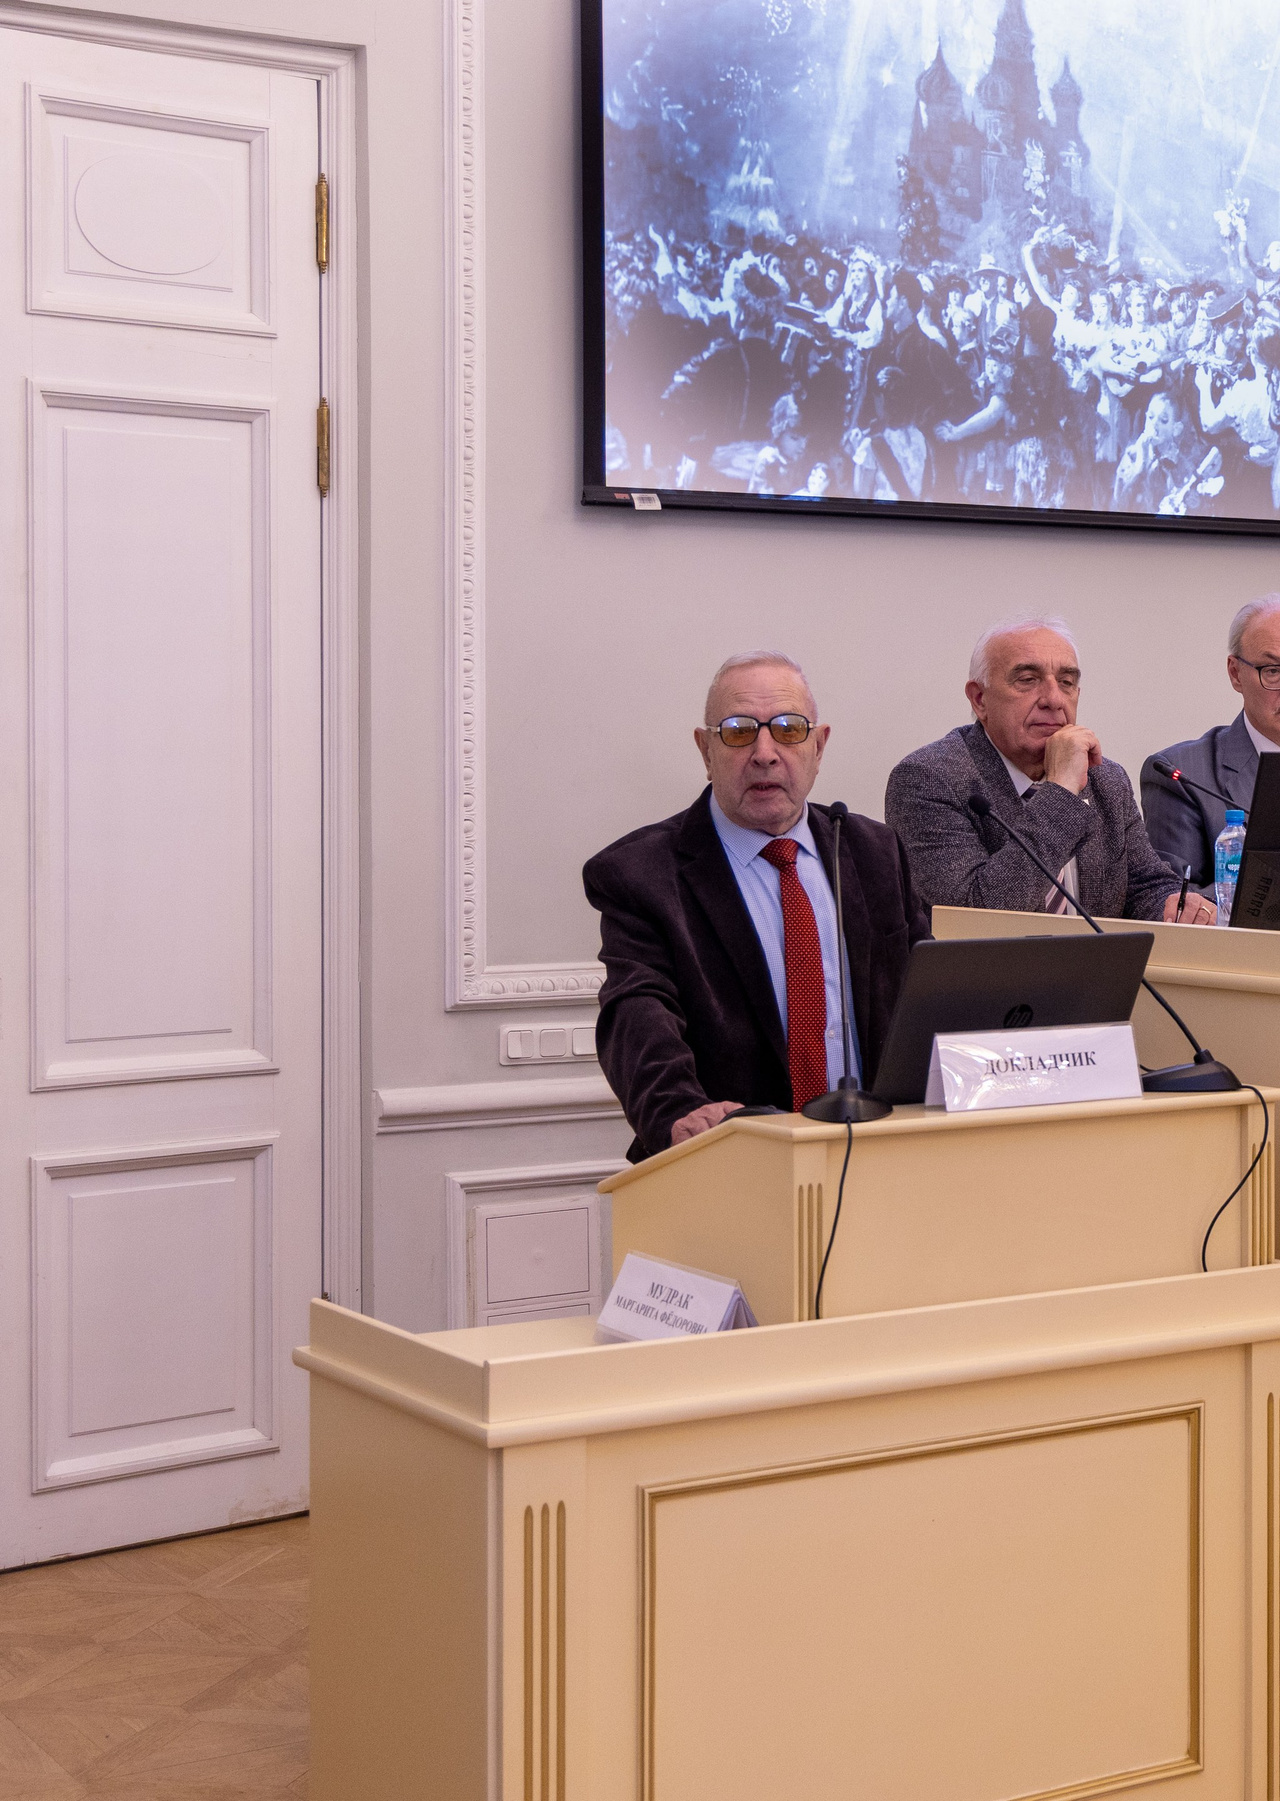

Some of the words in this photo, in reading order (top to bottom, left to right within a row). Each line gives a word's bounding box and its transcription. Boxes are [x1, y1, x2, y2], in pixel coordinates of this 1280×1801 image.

[984, 1051, 1097, 1076] ДОКЛАДЧИК
[647, 1282, 694, 1310] МУДРАК
[614, 1295, 659, 1320] МАРГАРИТА
[660, 1311, 708, 1335] ФЁДОРОВНА
